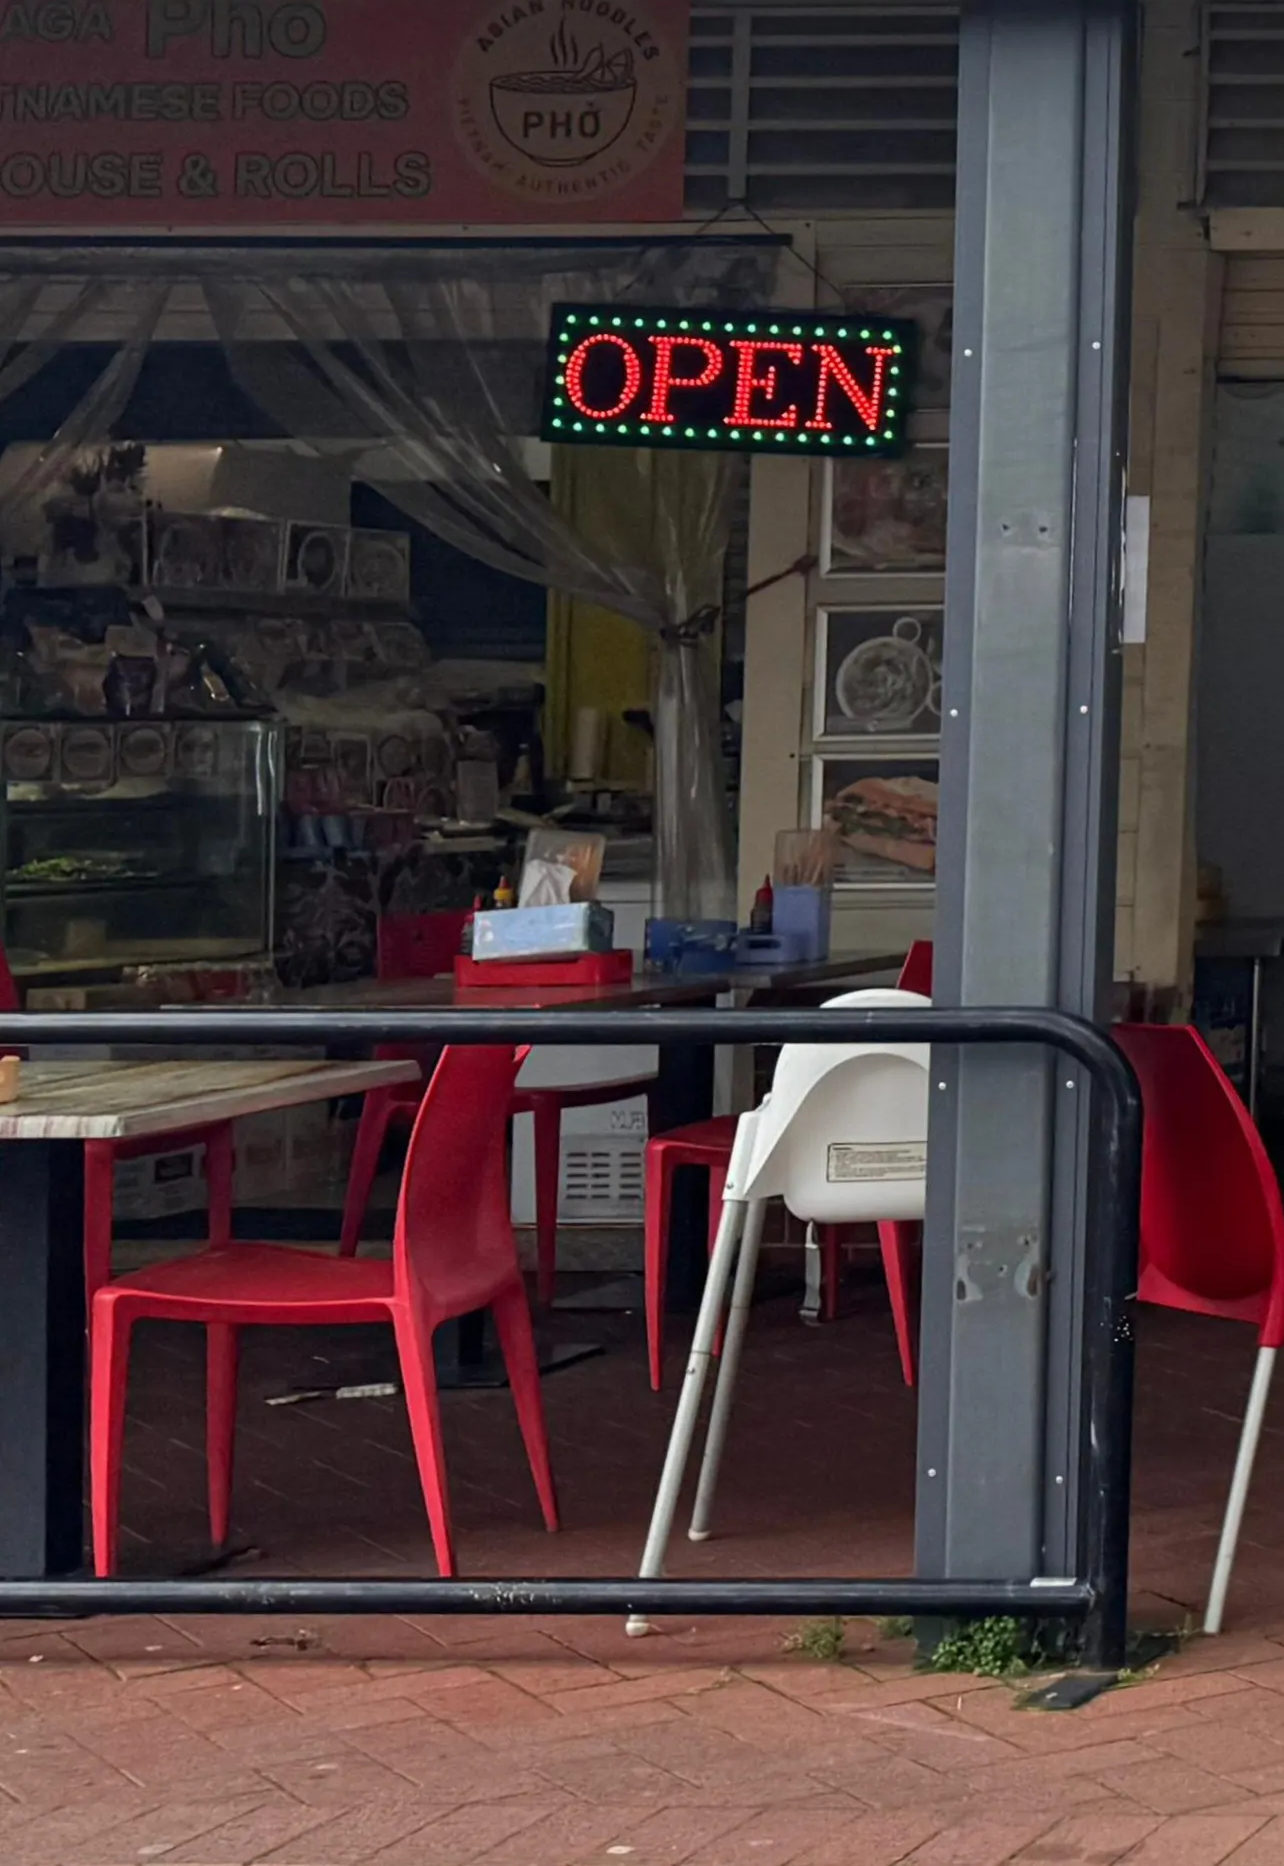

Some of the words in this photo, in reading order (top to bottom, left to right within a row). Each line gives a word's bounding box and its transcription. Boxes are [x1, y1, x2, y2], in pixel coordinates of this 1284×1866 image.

[233, 80, 411, 122] FOODS
[0, 150, 165, 201] OUSE
[178, 151, 220, 200] &
[234, 150, 433, 201] ROLLS
[563, 332, 894, 433] OPEN
